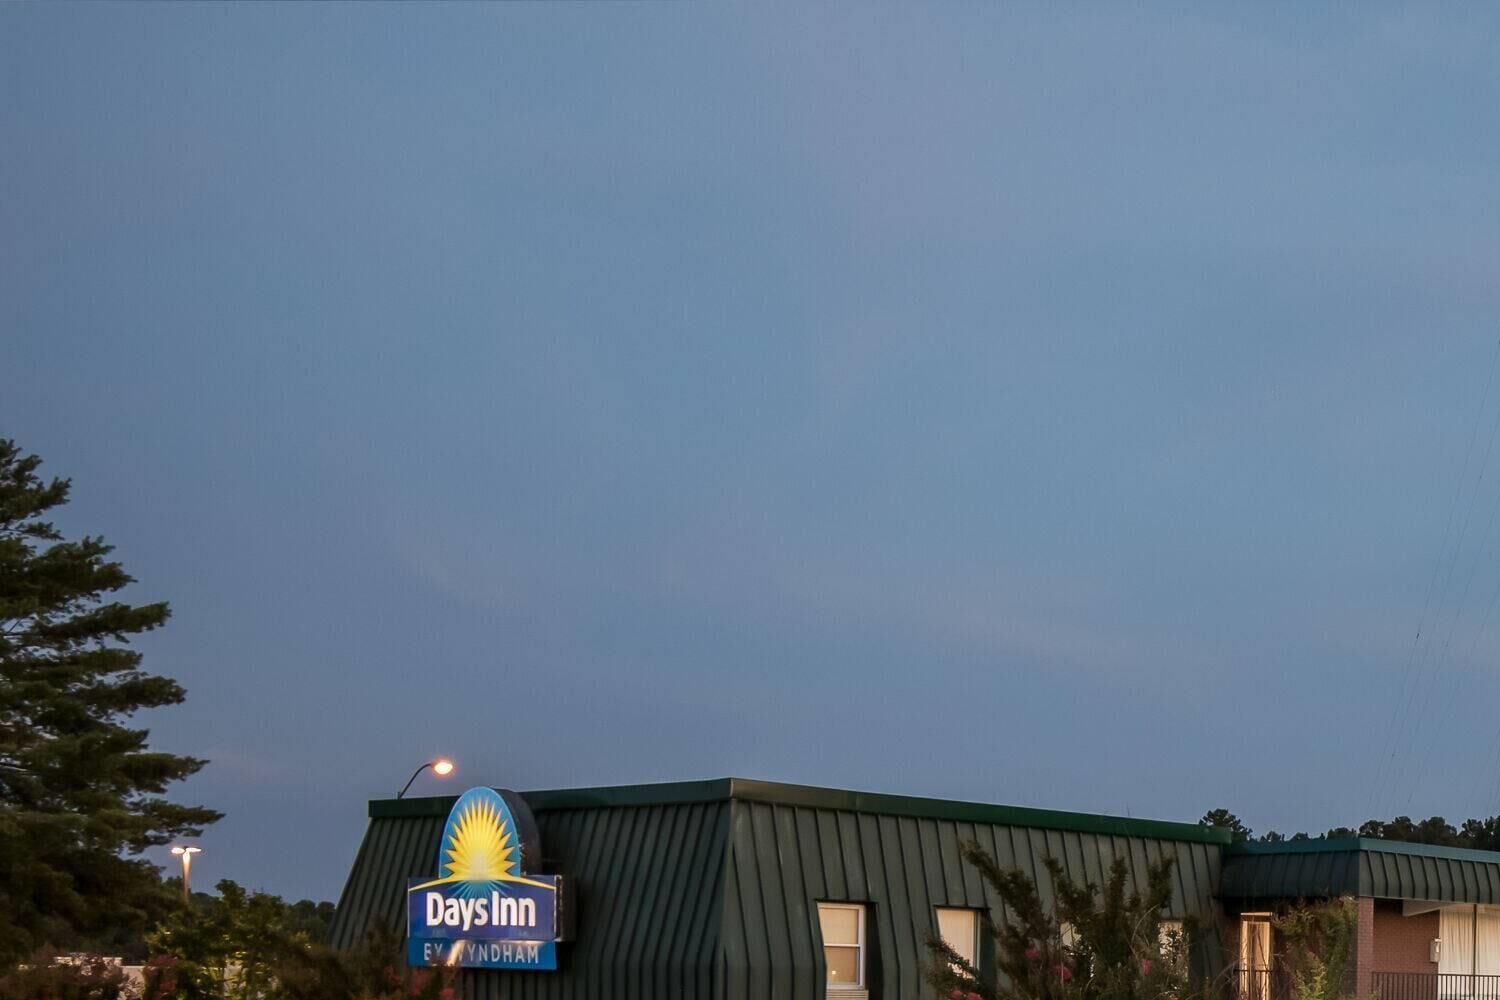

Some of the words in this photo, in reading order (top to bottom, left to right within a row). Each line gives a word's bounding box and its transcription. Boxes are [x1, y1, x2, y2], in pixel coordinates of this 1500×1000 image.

[426, 891, 488, 931] Days
[491, 891, 536, 927] Inn
[423, 943, 443, 961] BY
